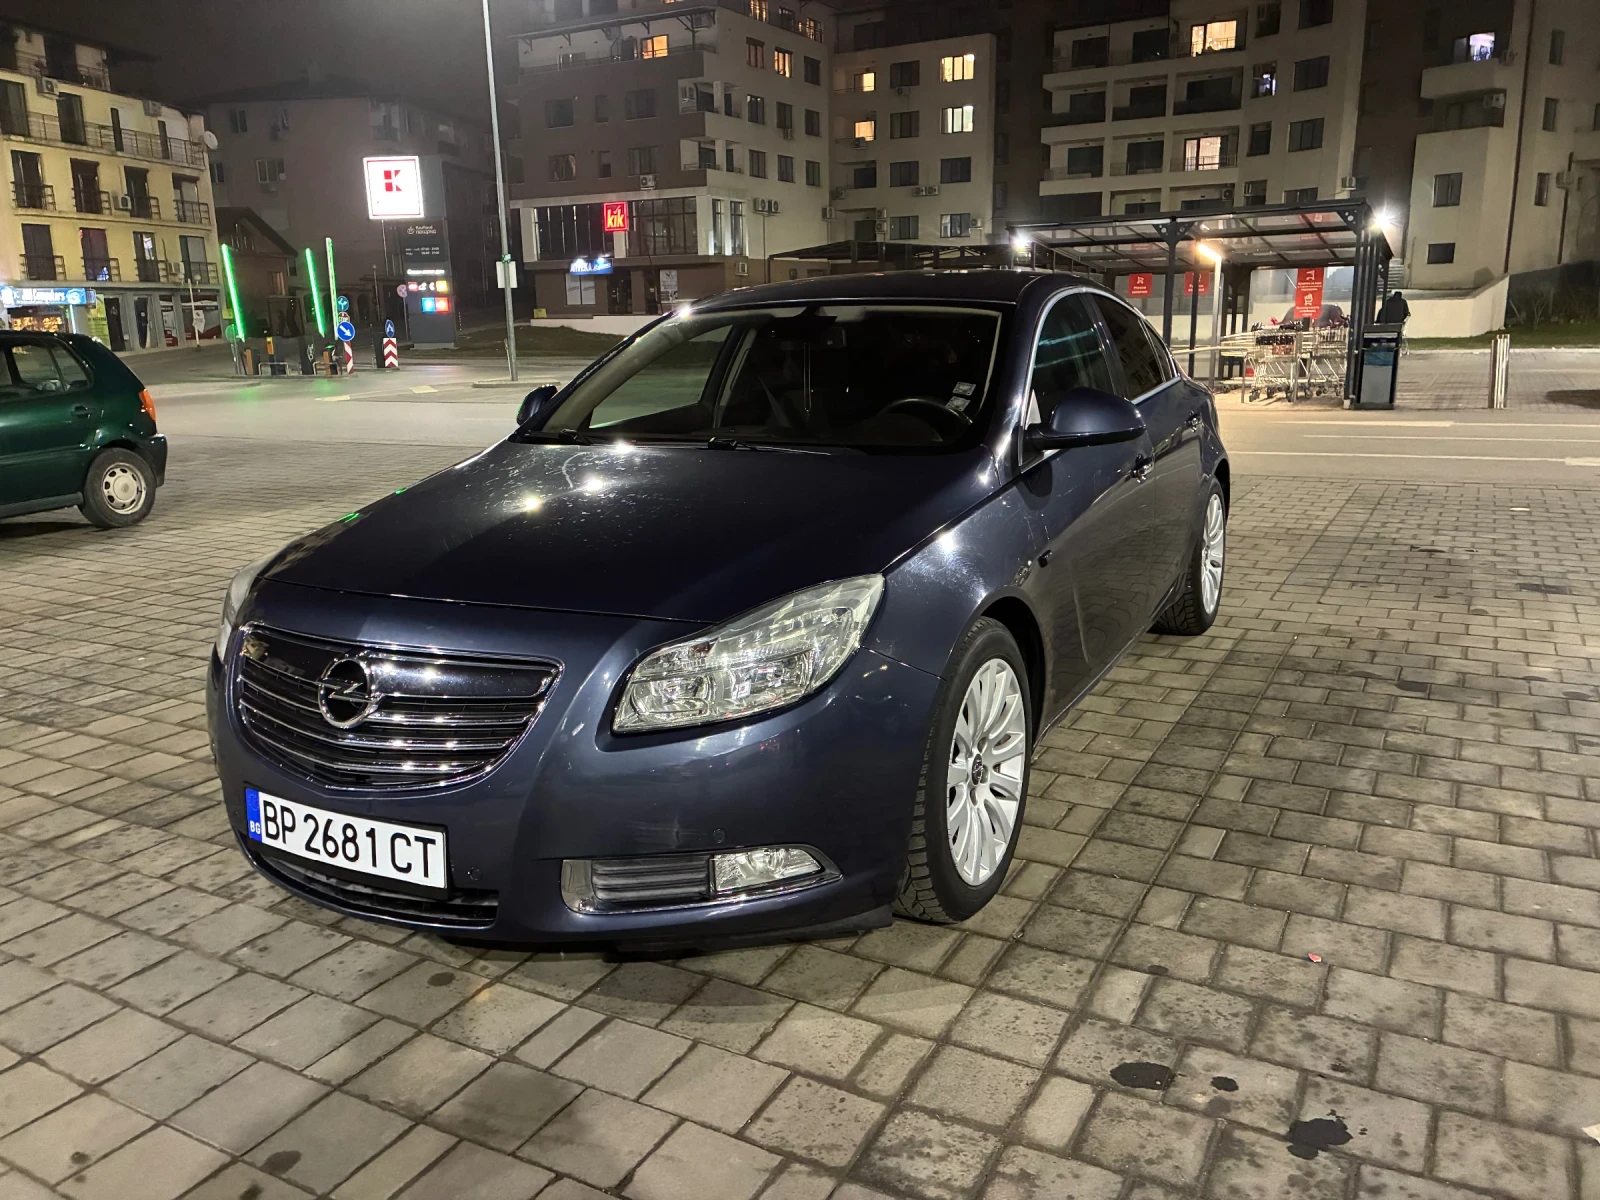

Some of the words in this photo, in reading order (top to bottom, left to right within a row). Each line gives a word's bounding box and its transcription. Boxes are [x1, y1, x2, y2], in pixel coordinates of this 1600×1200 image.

[607, 205, 624, 228] kik
[249, 820, 261, 834] BG
[263, 800, 296, 844] BP
[303, 814, 377, 867] 2681
[390, 832, 436, 878] CT
